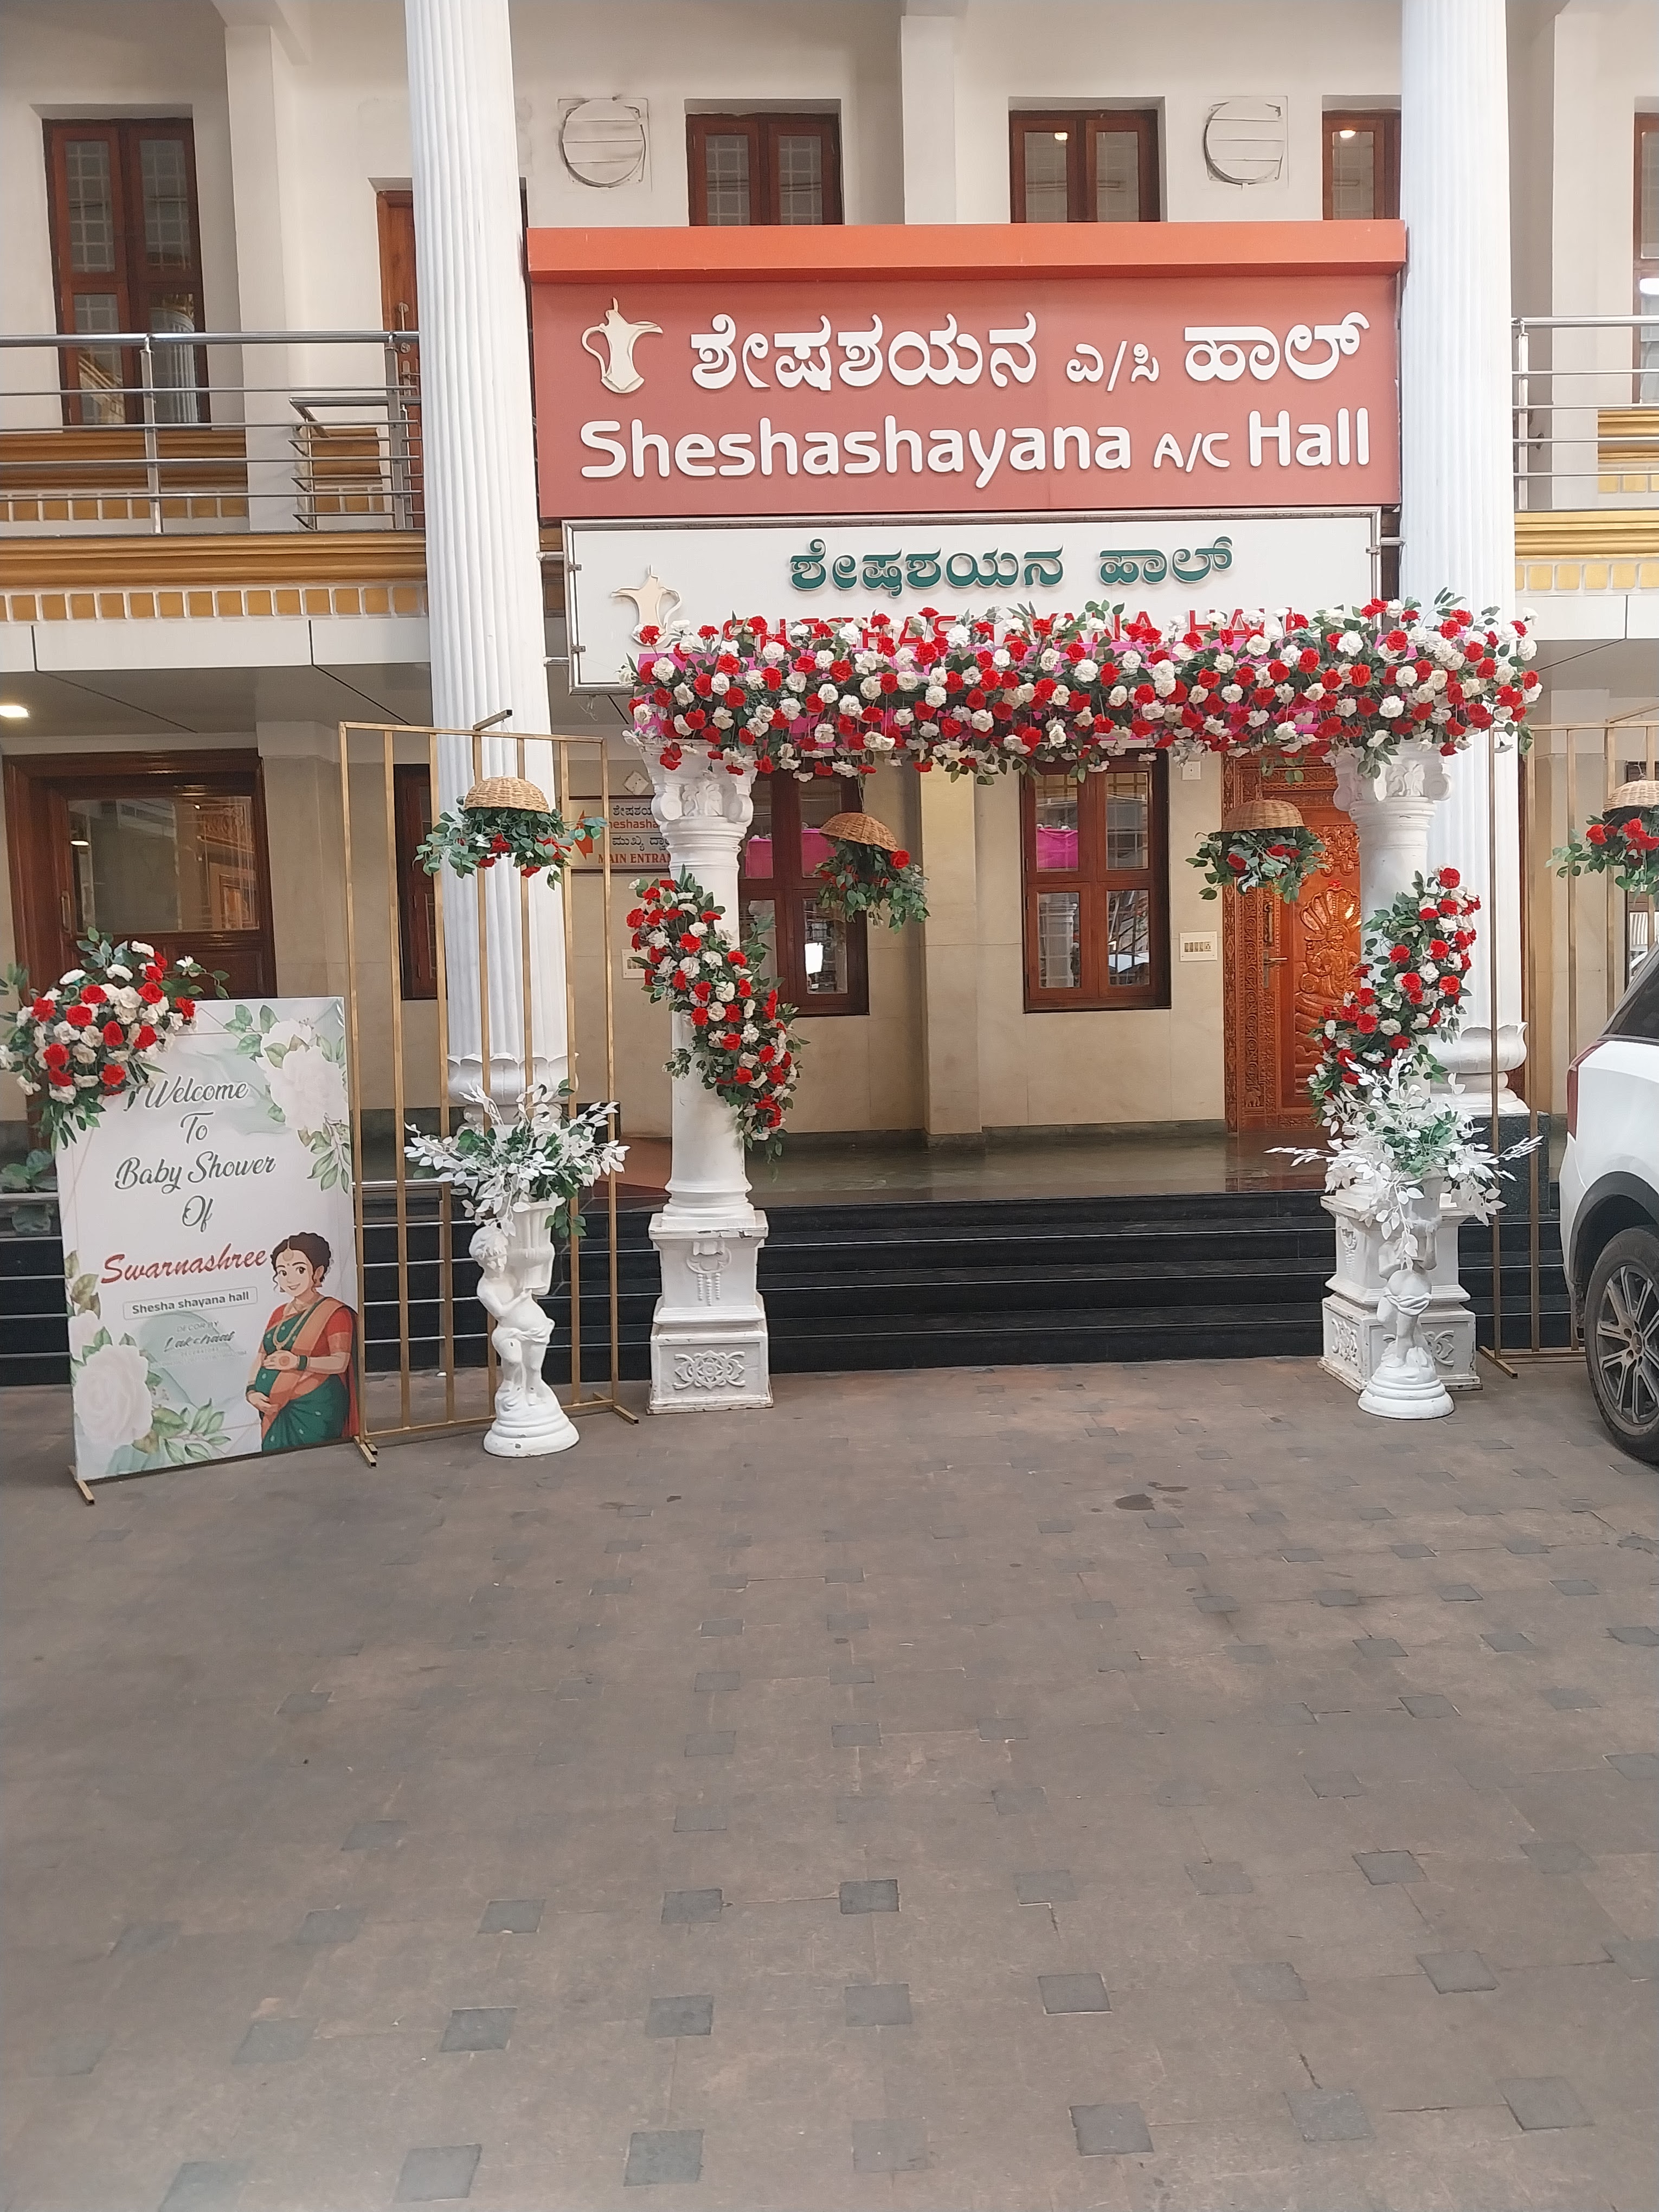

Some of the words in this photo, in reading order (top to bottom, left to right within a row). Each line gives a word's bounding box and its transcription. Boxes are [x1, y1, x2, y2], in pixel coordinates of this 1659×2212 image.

[690, 311, 1037, 391] ಶೇಷಶಯನ
[1066, 340, 1160, 391] ಎ/ಸಿ
[1184, 311, 1370, 382] ಹಾಲ್
[580, 414, 1131, 489] Sheshashayana
[1153, 433, 1230, 473] A/C
[1249, 407, 1370, 467] Hall
[789, 538, 1064, 597] ಶೇಷಶಯನ
[1098, 536, 1233, 585] ಹಾಲ್
[613, 805, 653, 816] ಶೇಷಶಯ
[612, 835, 645, 852] ಮುಖ್ಯ
[137, 1076, 249, 1108] Welcome
[180, 1111, 214, 1144] To
[114, 1156, 183, 1194] Baby
[188, 1150, 276, 1183] Shower
[182, 1195, 214, 1233] Of
[100, 1243, 267, 1284] Swarnashree
[132, 1301, 175, 1315] Shesha
[177, 1295, 226, 1309] shayana
[228, 1290, 249, 1302] hall
